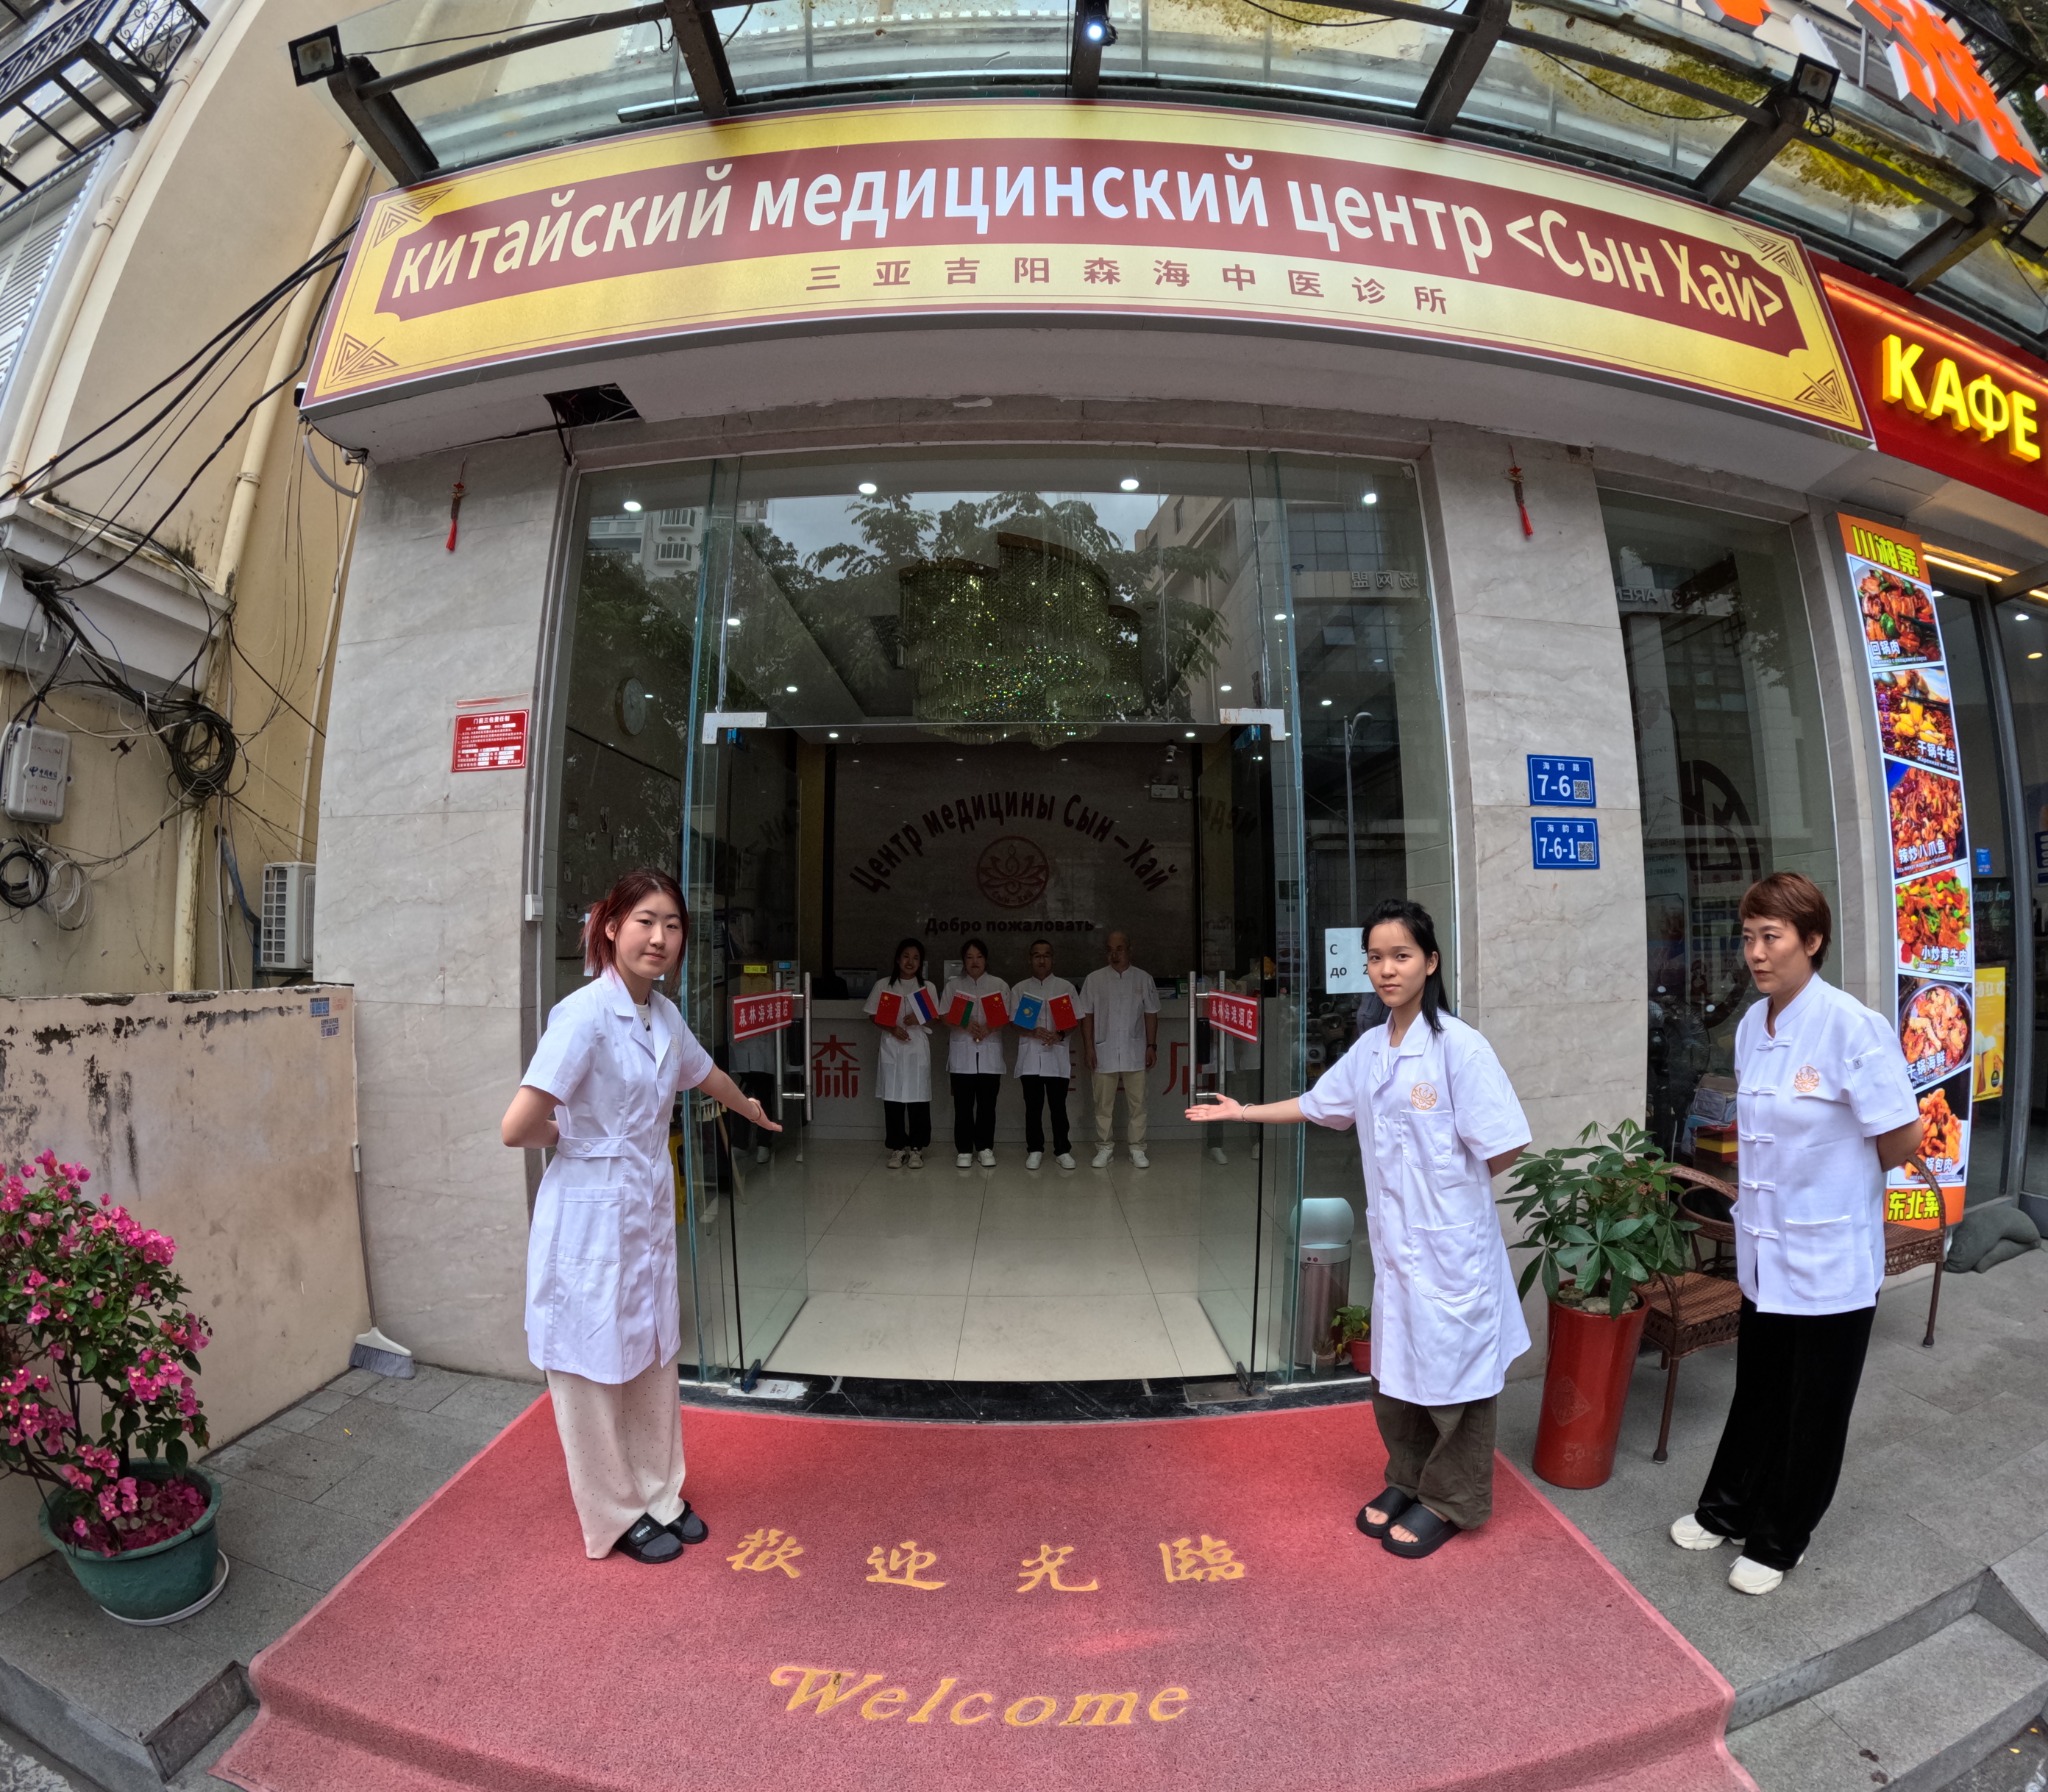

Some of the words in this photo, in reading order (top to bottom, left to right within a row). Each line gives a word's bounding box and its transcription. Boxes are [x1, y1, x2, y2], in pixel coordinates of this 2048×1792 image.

[391, 163, 733, 299] китайский
[749, 153, 1269, 241] медицинский
[1287, 180, 1494, 274] центр
[805, 255, 1448, 315] 三亚吉阳森海中医诊所
[1882, 334, 2041, 463] КАФЕ
[1851, 525, 1921, 578] 川湘菜
[1537, 774, 1571, 797] 7-6
[850, 823, 924, 893] Центр
[922, 791, 1056, 838] медицины
[1539, 837, 1577, 859] 7-6-1
[925, 917, 982, 935] Добро
[986, 918, 1095, 933] пожаловать
[1330, 966, 1347, 979] до
[1921, 945, 1969, 966] 小炒黄牛肉
[1886, 1190, 1941, 1222] 东北菜
[769, 1665, 1192, 1727] Welcome
